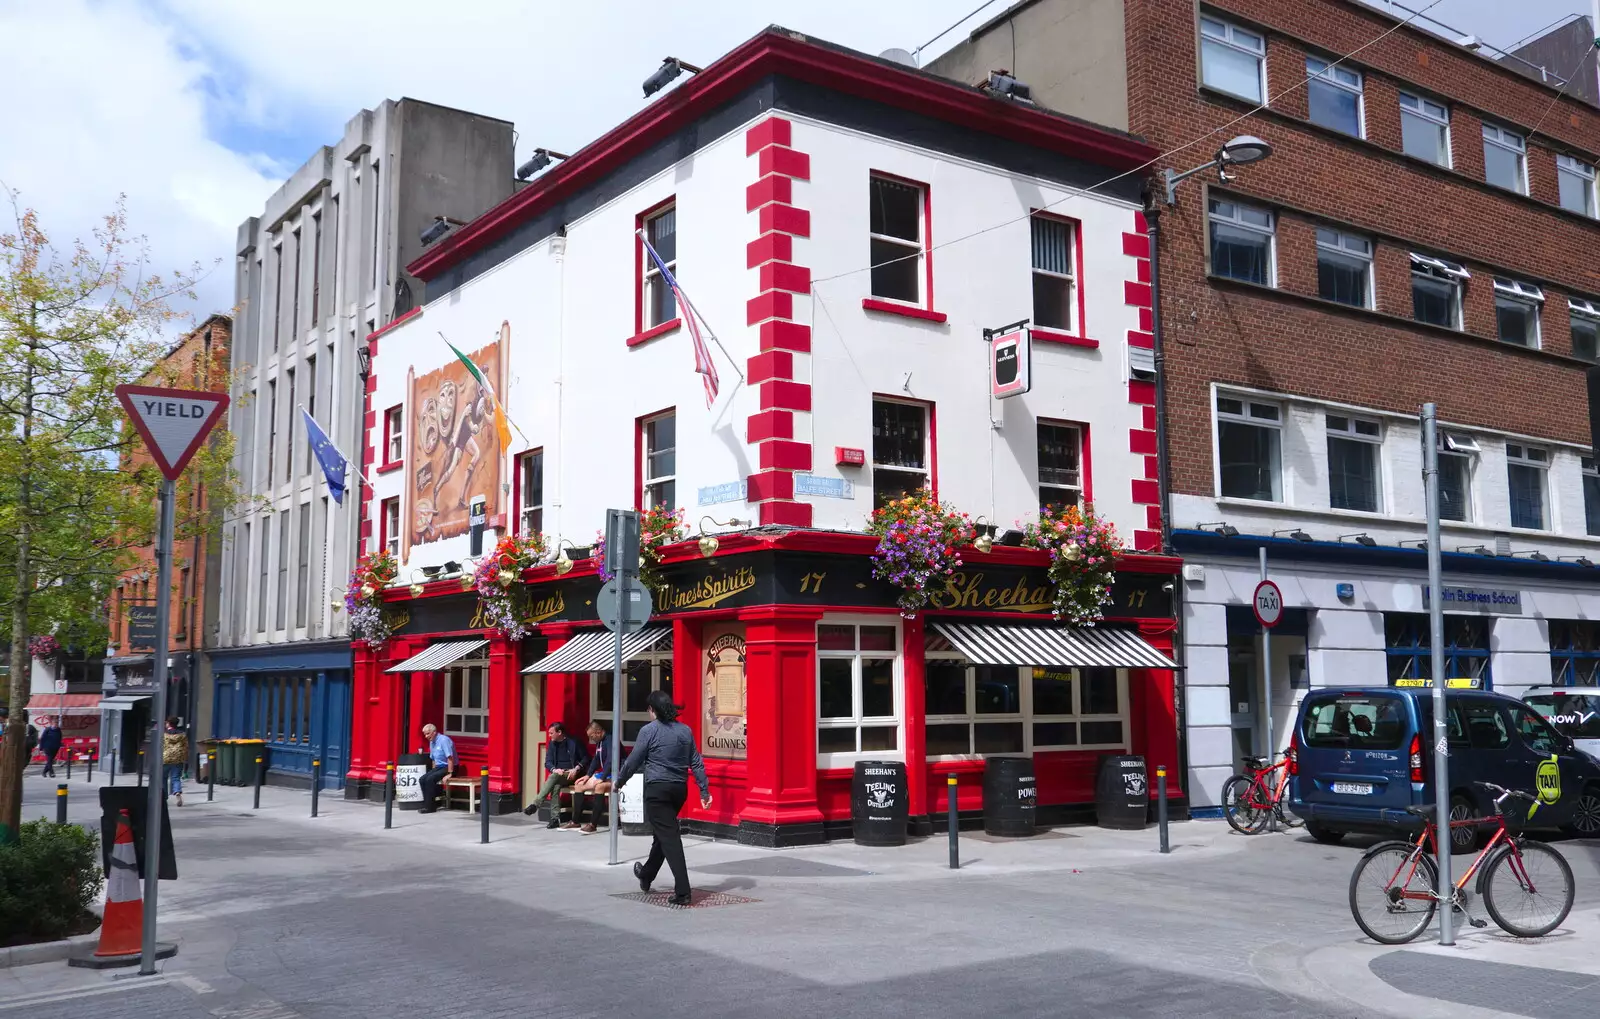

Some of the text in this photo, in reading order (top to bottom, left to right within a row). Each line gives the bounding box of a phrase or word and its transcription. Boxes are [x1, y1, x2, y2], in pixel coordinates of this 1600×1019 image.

[143, 400, 205, 419] YIELD
[818, 486, 843, 495] STREET
[658, 583, 697, 611] Wines
[702, 566, 756, 608] Spirits
[800, 571, 827, 594] 17
[929, 572, 1058, 609] Sheeha
[1457, 589, 1491, 604] Business
[1491, 591, 1518, 605] School
[1128, 589, 1148, 608] 17
[1258, 596, 1279, 610] TAXI
[707, 735, 747, 749] GUINNES
[864, 768, 897, 776] SHEEHAN'S
[865, 782, 896, 794] TEELING
[1539, 774, 1558, 789] TAXI
[867, 799, 895, 809] DISTILLERY
